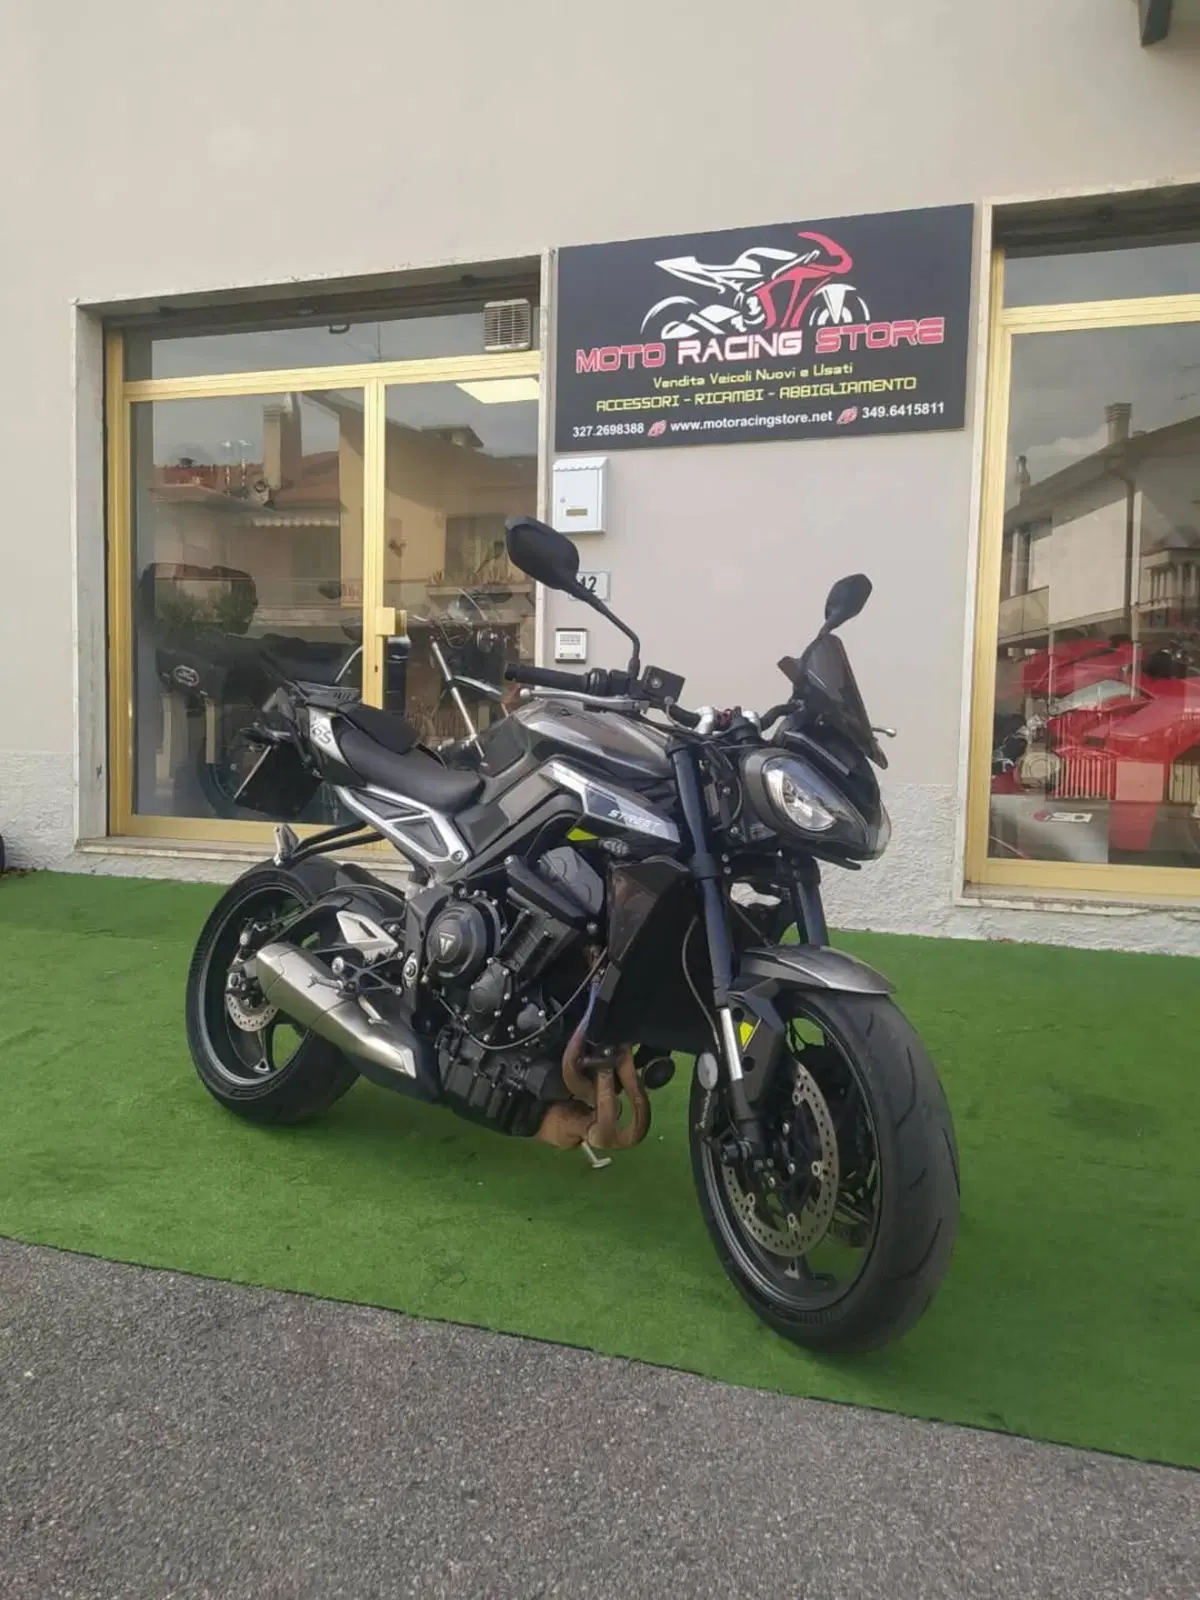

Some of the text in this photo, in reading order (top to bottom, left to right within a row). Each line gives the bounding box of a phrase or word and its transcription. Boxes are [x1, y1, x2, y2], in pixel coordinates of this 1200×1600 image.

[576, 316, 945, 374] MOTO RACING STORE
[653, 362, 853, 389] Vendita Veicoli Nuovi e Usati
[596, 394, 680, 412] ACCESSORI
[695, 388, 764, 406] RICAMBI
[779, 377, 917, 400] ABBIGLIAMENTO
[572, 402, 945, 438] 327.2698388 www.motoracingstore.net 349.6415811
